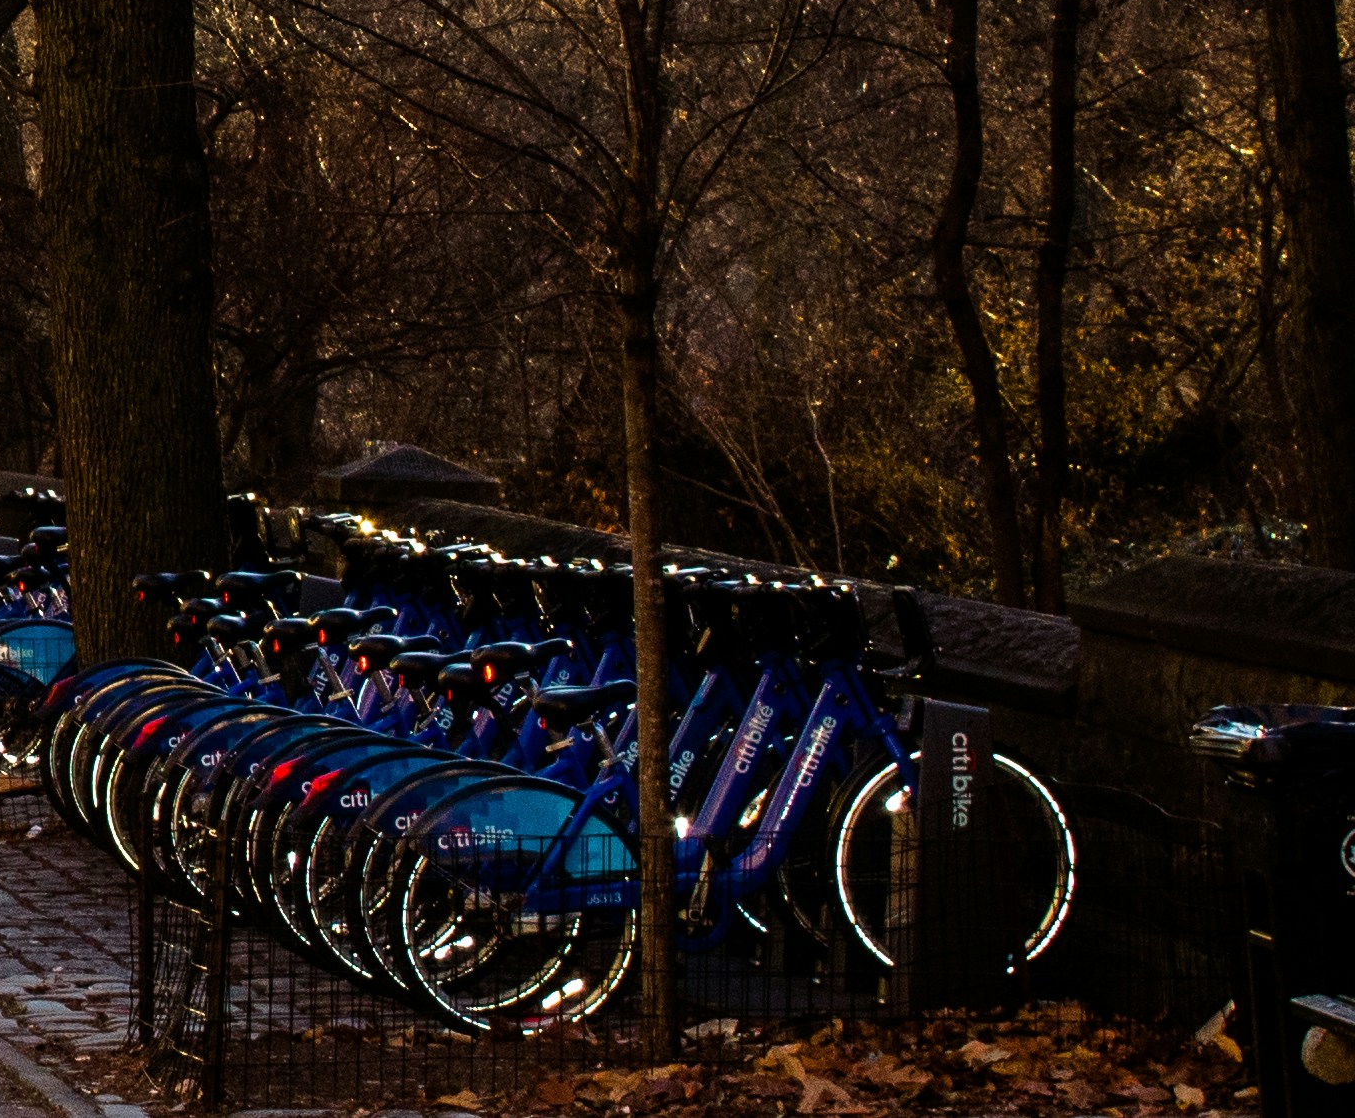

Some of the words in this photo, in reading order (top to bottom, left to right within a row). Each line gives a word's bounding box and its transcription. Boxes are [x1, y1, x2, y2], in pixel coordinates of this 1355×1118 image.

[952, 732, 972, 771] citi
[340, 790, 368, 808] citi
[952, 775, 973, 828] bike
